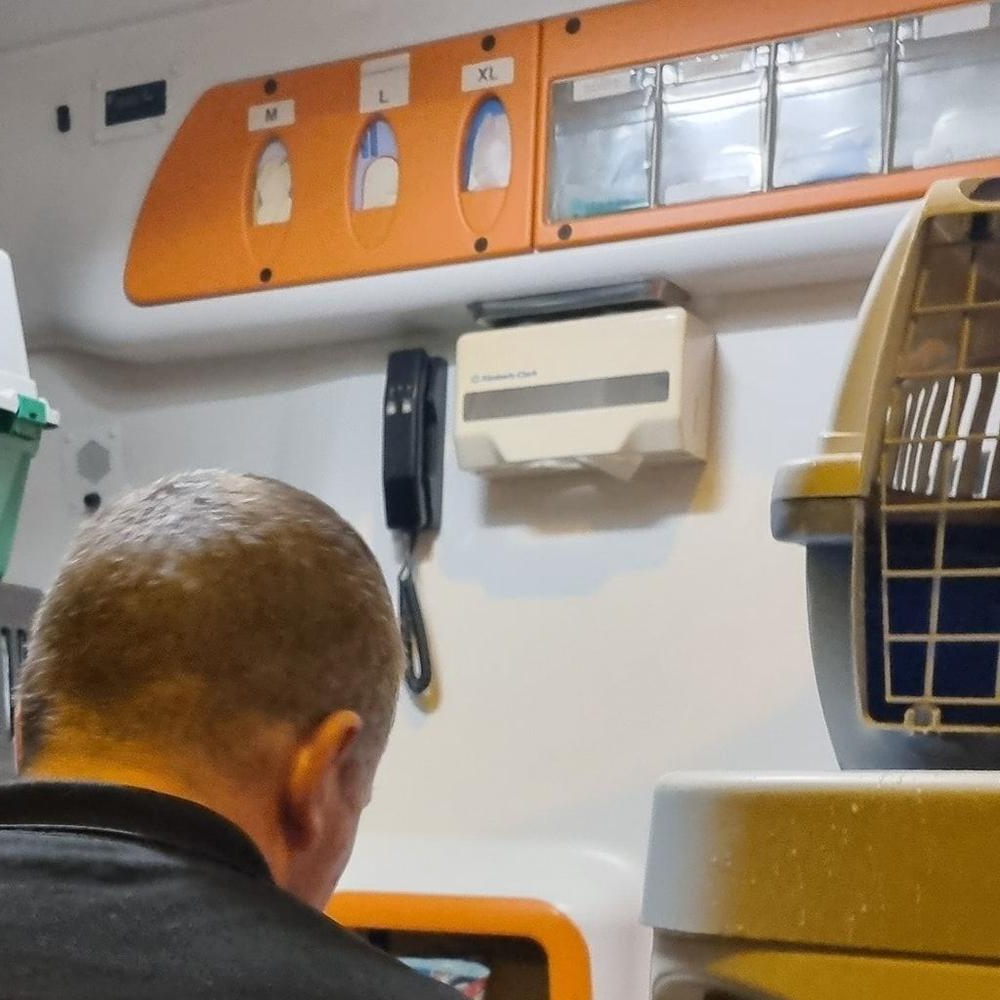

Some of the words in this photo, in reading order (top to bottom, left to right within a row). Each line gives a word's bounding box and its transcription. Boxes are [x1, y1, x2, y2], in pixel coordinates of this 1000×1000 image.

[477, 67, 497, 81] XL
[378, 91, 387, 104] L
[265, 107, 278, 122] M
